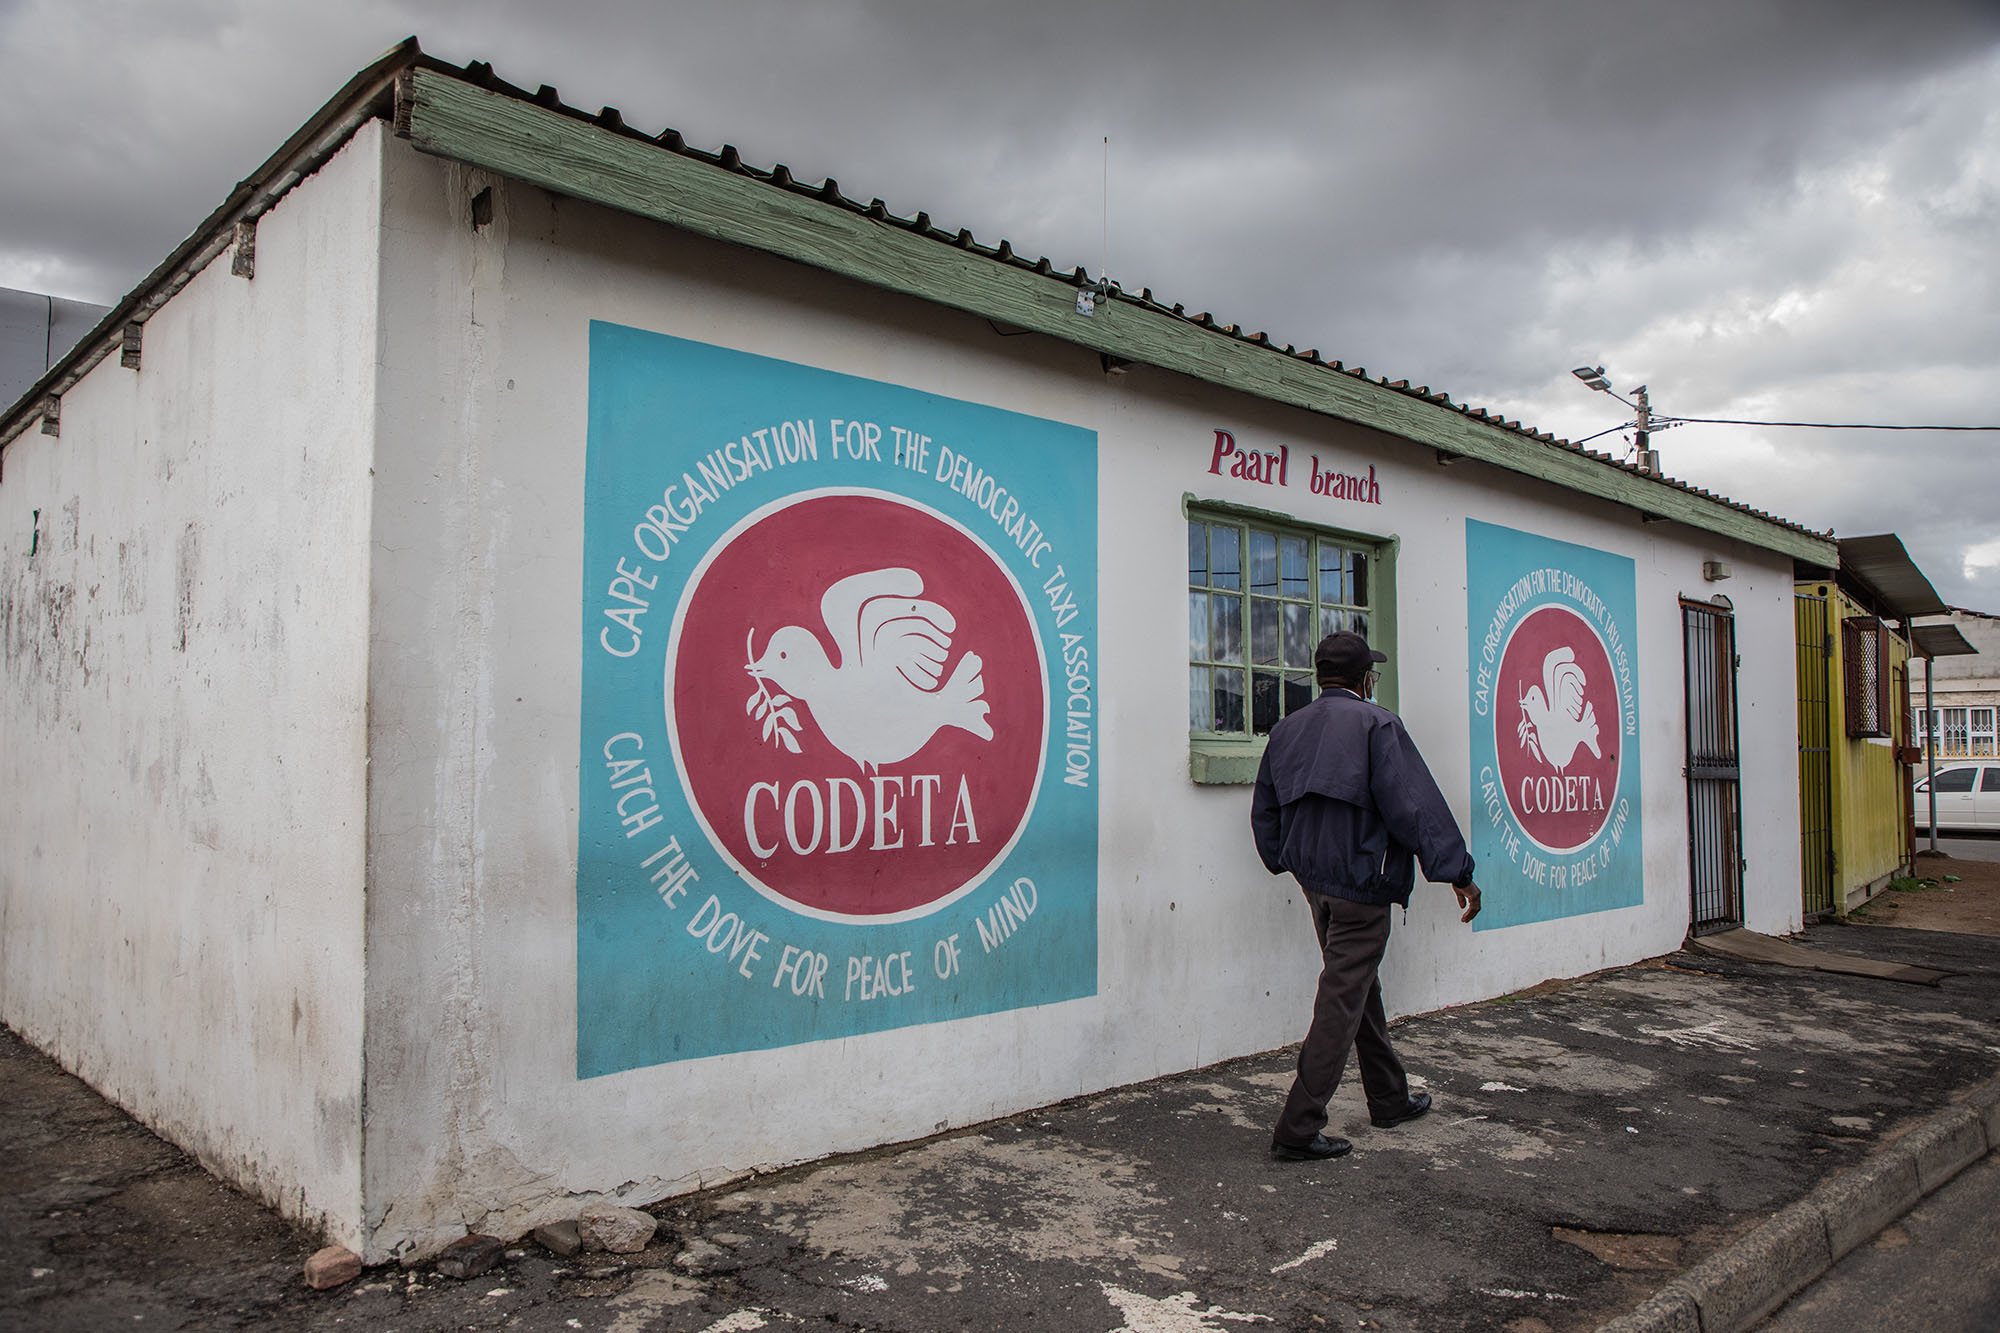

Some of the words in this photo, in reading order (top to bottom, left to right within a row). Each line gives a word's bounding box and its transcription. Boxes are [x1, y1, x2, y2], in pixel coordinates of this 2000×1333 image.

[831, 419, 882, 462] FOR
[891, 426, 932, 474] THE
[1208, 428, 1290, 487] Paarl
[1310, 454, 1382, 505] branch
[634, 419, 817, 562] ORGANISATION
[936, 445, 1052, 568] DEMOCRATIC
[600, 557, 657, 658] CAPE
[1043, 564, 1078, 629] TAXI
[1483, 574, 1532, 664] ORGANISATION
[1531, 569, 1546, 595] FOR
[1546, 568, 1562, 593] THE
[1563, 571, 1607, 624] DEMOCRATIC
[1603, 612, 1620, 649] TAXI
[1059, 633, 1091, 787] ASSOCIATION
[1475, 662, 1493, 716] CAPE
[1614, 644, 1636, 736] ASSOCIATION
[743, 774, 981, 859] CODETA
[1480, 766, 1504, 828] CATCH
[1500, 820, 1521, 863] THE
[1522, 851, 1546, 885] DOVE
[1550, 866, 1567, 889] FOR
[1571, 854, 1597, 887] PEACE
[1599, 838, 1611, 868] OF
[1610, 797, 1630, 847] MIND
[1521, 776, 1605, 814] CODETA
[603, 732, 663, 839] CATCH
[640, 835, 700, 910] THE
[685, 894, 769, 980] DOVE
[773, 946, 828, 999] FOR
[845, 951, 915, 1001] PEACE
[934, 933, 962, 980] OF
[975, 877, 1038, 953] MIND
